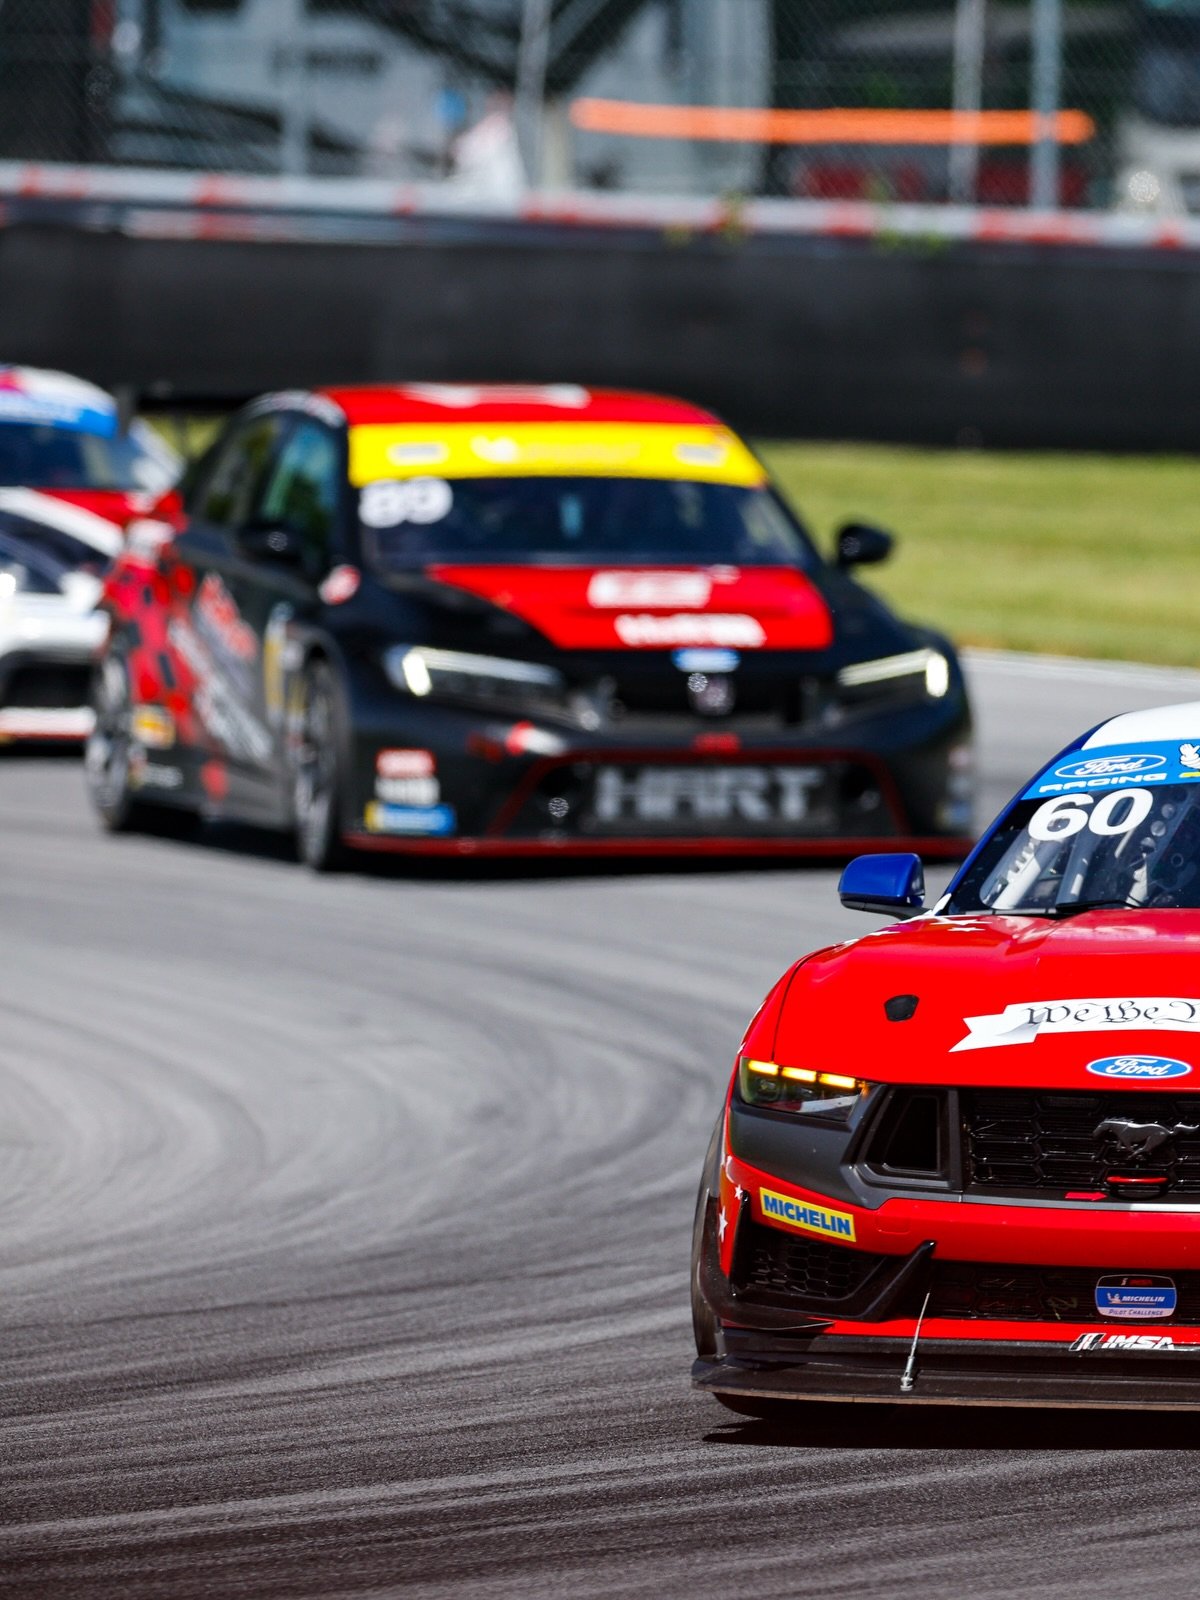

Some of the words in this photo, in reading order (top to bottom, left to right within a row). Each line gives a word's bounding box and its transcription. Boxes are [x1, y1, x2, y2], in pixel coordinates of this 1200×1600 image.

[1074, 756, 1147, 776] Ford
[1039, 773, 1168, 793] RACING
[596, 766, 827, 822] HART
[1028, 788, 1154, 841] 60
[1023, 1004, 1097, 1026] We
[1105, 1058, 1173, 1075] Ford
[763, 1194, 852, 1236] MICHELIN
[1101, 1335, 1175, 1351] IMSA
